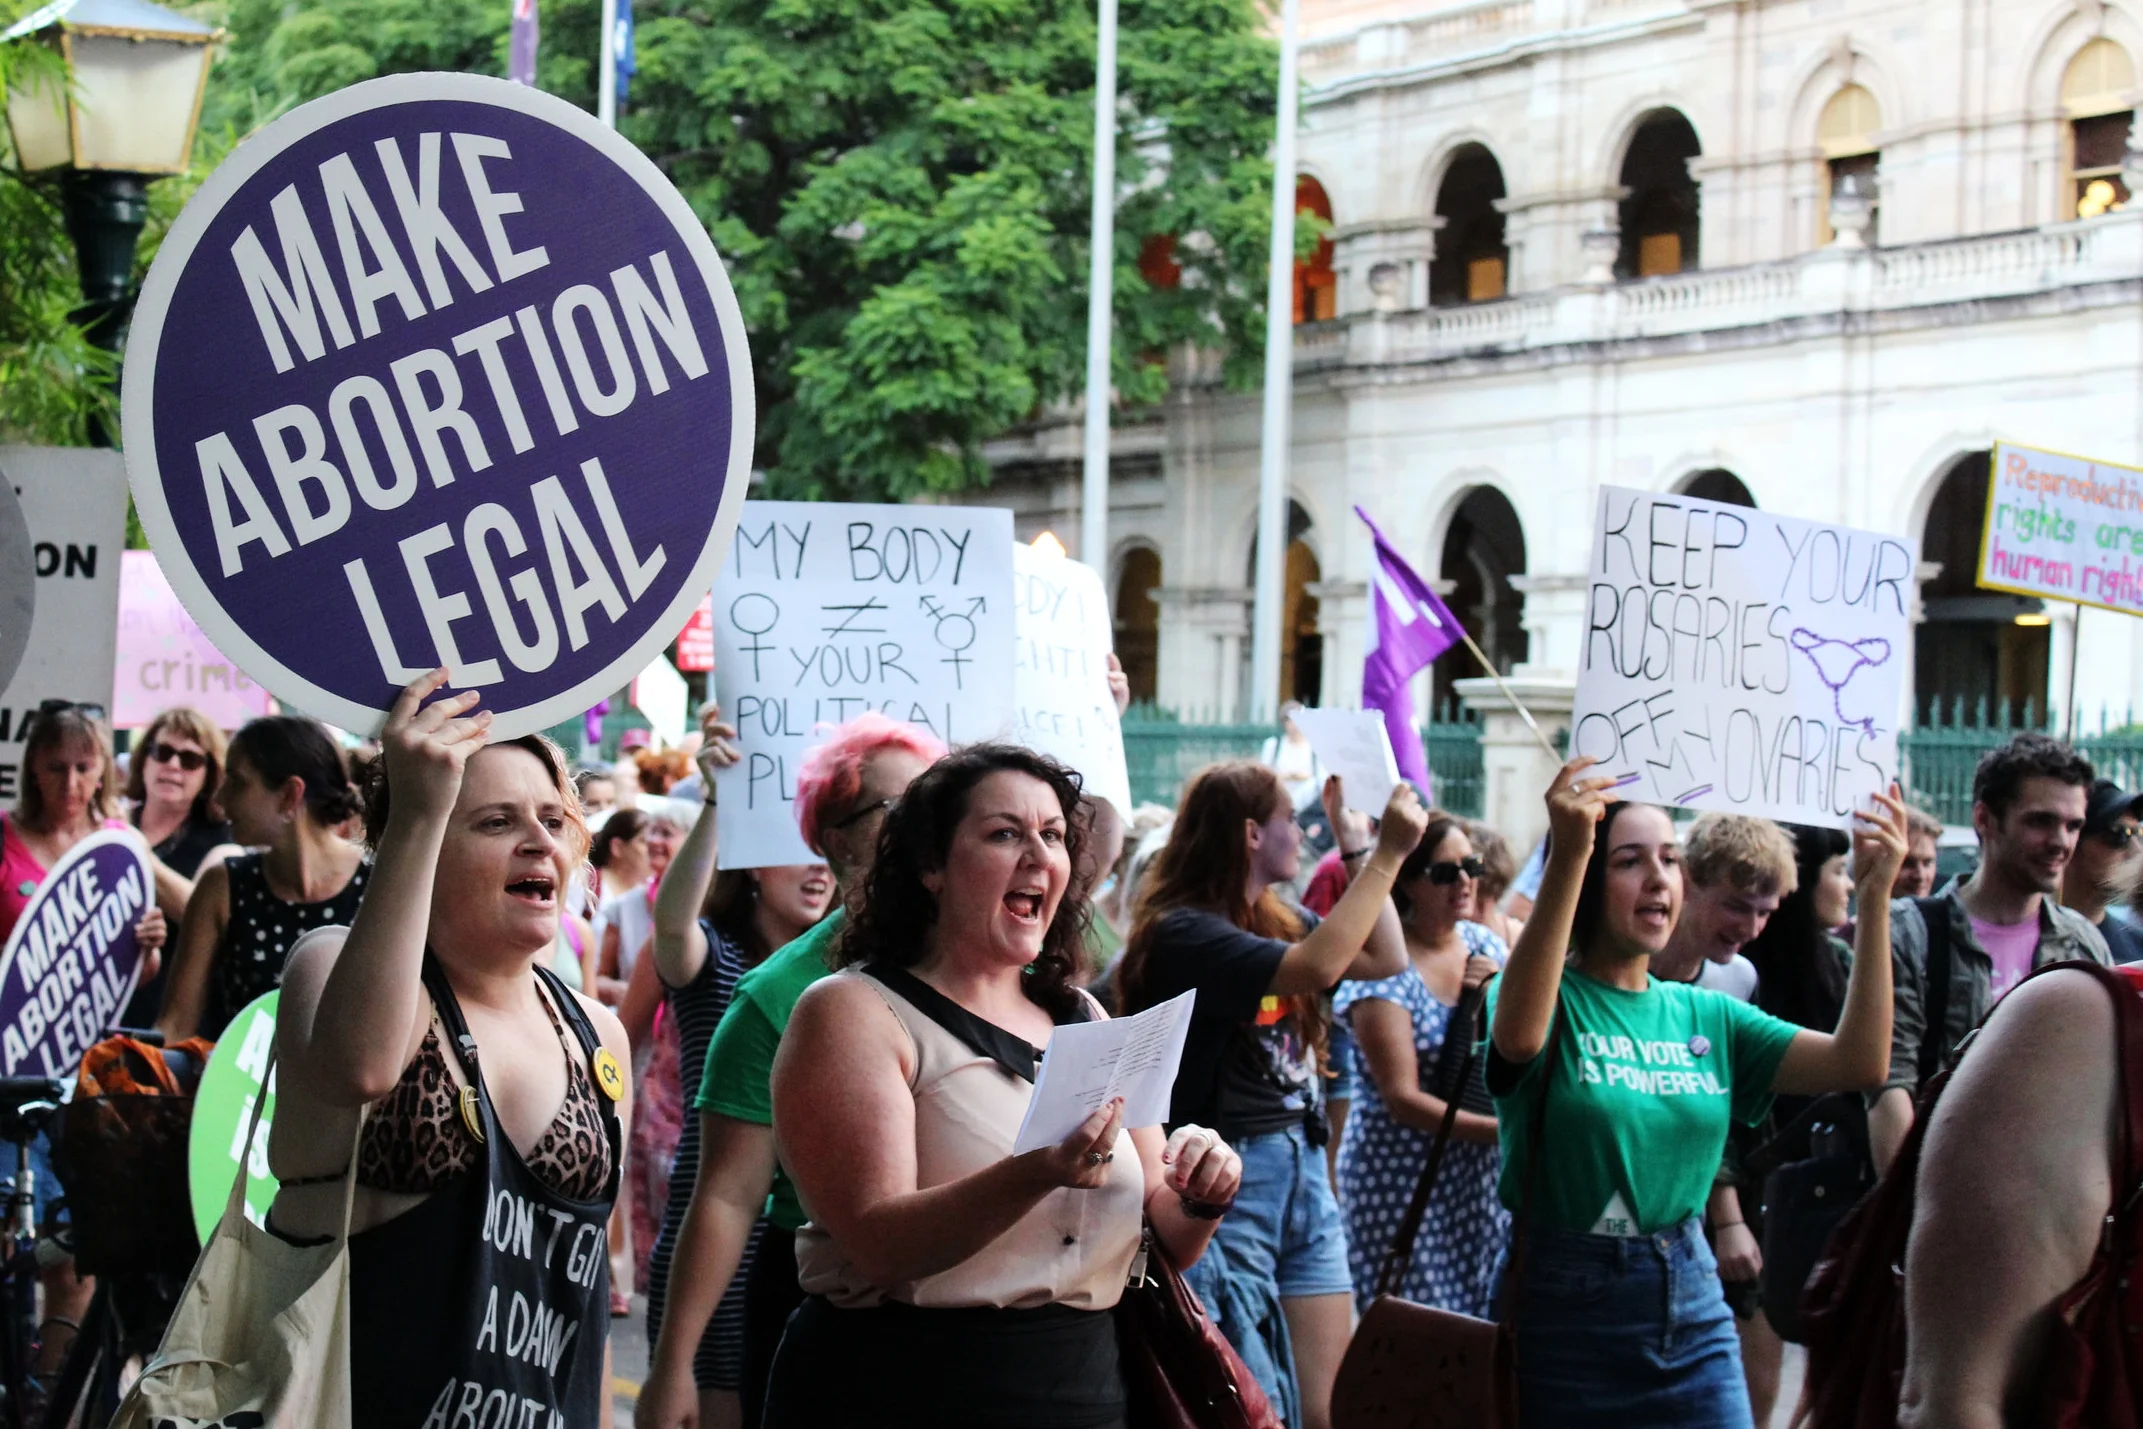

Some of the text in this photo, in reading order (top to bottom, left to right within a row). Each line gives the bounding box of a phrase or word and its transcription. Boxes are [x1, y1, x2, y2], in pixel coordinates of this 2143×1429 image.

[230, 132, 551, 375] MAKE
[194, 250, 710, 578] ABORTION
[343, 457, 667, 690] LEGAL
[735, 521, 972, 586] MY BODY
[1603, 491, 1911, 616] KEEP YOUR
[1991, 534, 2073, 589] human
[1996, 496, 2077, 544] rights
[790, 642, 919, 688] YOUR
[1587, 583, 1792, 695] ROSARIES
[1575, 690, 1886, 817] OFF MY OVARIES
[2, 864, 144, 1077] ABORTION
[16, 857, 104, 993] MAKE
[38, 955, 128, 1079] LEGAL
[1578, 1056, 1602, 1084] IS
[1636, 1038, 1696, 1067] VOTE
[1604, 1217, 1630, 1234] THE
[476, 1285, 499, 1353] A
